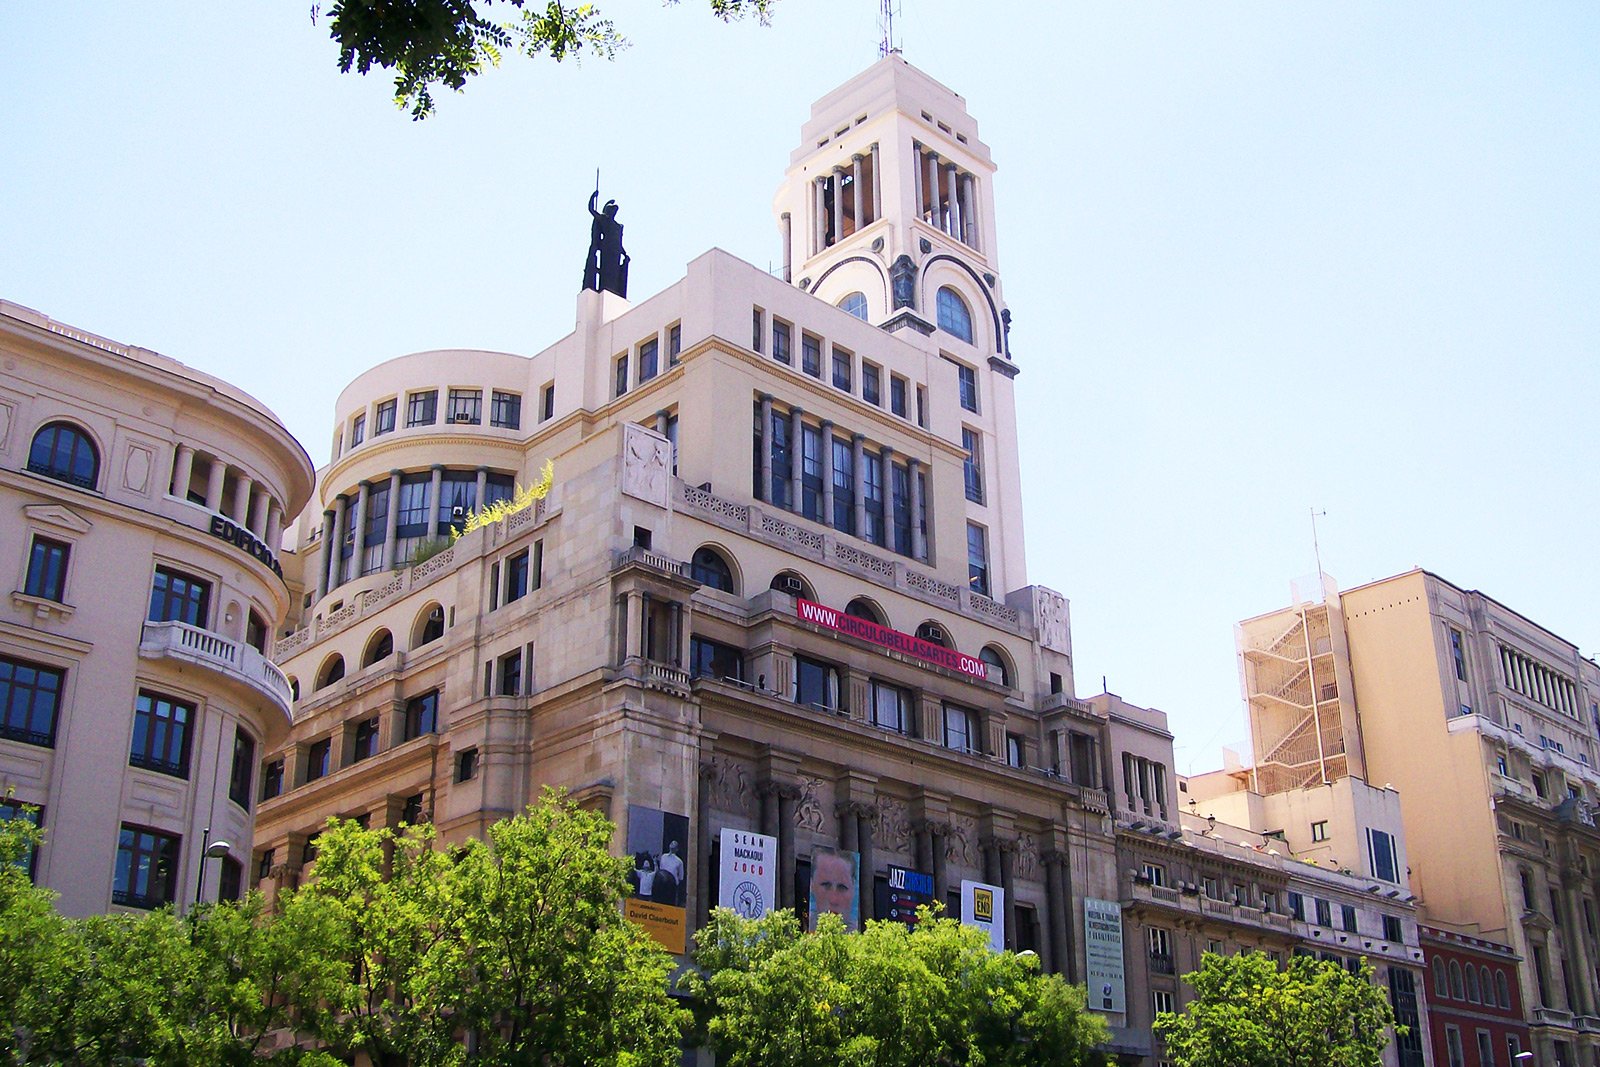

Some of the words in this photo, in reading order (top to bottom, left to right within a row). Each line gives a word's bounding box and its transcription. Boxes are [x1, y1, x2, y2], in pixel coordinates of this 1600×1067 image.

[801, 602, 985, 677] WWW.CIRCULOBELLASARTES.COM
[734, 833, 764, 848] SEAN
[734, 862, 764, 876] ZOCO
[976, 900, 991, 914] END
[629, 910, 648, 920] David
